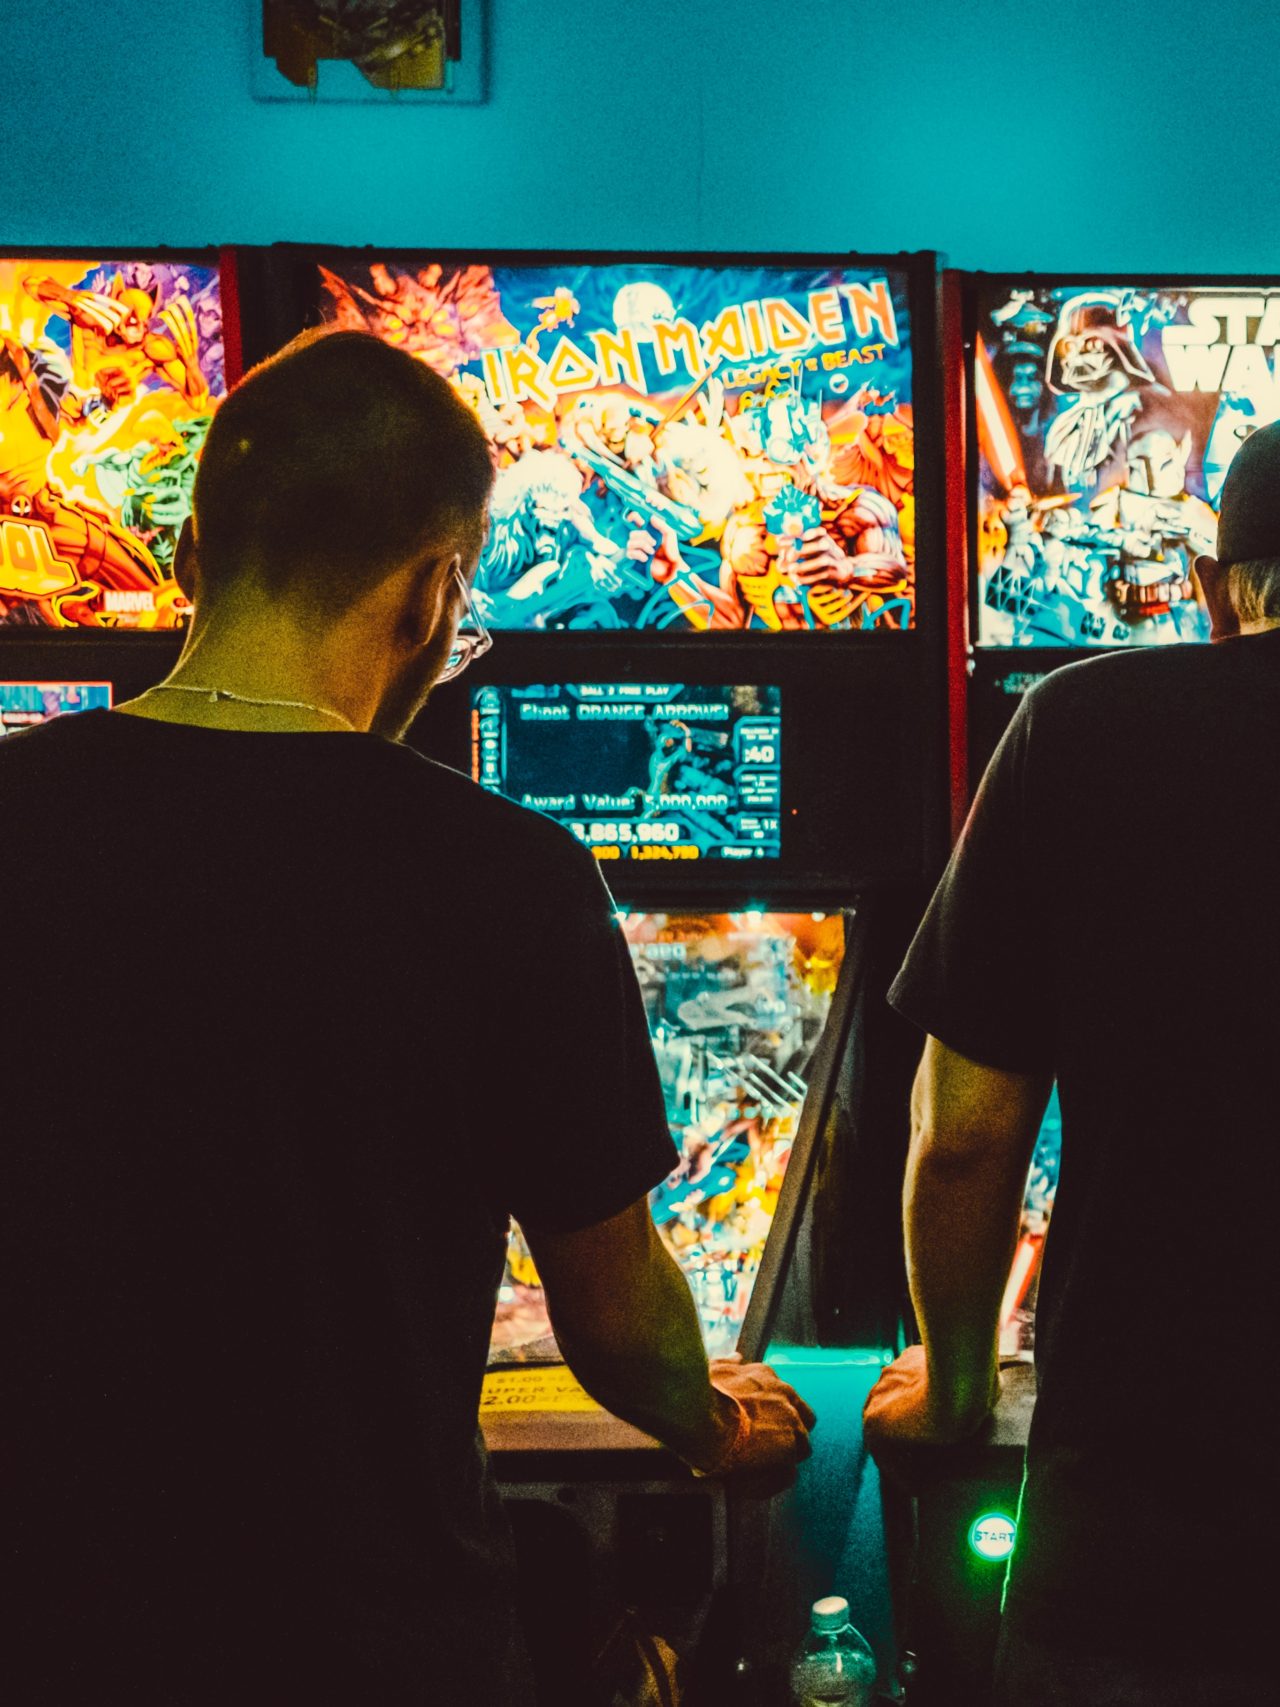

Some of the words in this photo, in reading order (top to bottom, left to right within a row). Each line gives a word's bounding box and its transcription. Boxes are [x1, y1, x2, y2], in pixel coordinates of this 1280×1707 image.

[482, 328, 648, 412] IRON
[653, 277, 899, 379] MAIDEN
[721, 359, 802, 389] LEGACY
[821, 343, 886, 371] BEAST
[104, 590, 156, 612] MARVEL
[486, 1386, 545, 1394] UPER
[483, 1394, 536, 1406] 2.00
[975, 1530, 1016, 1543] START
